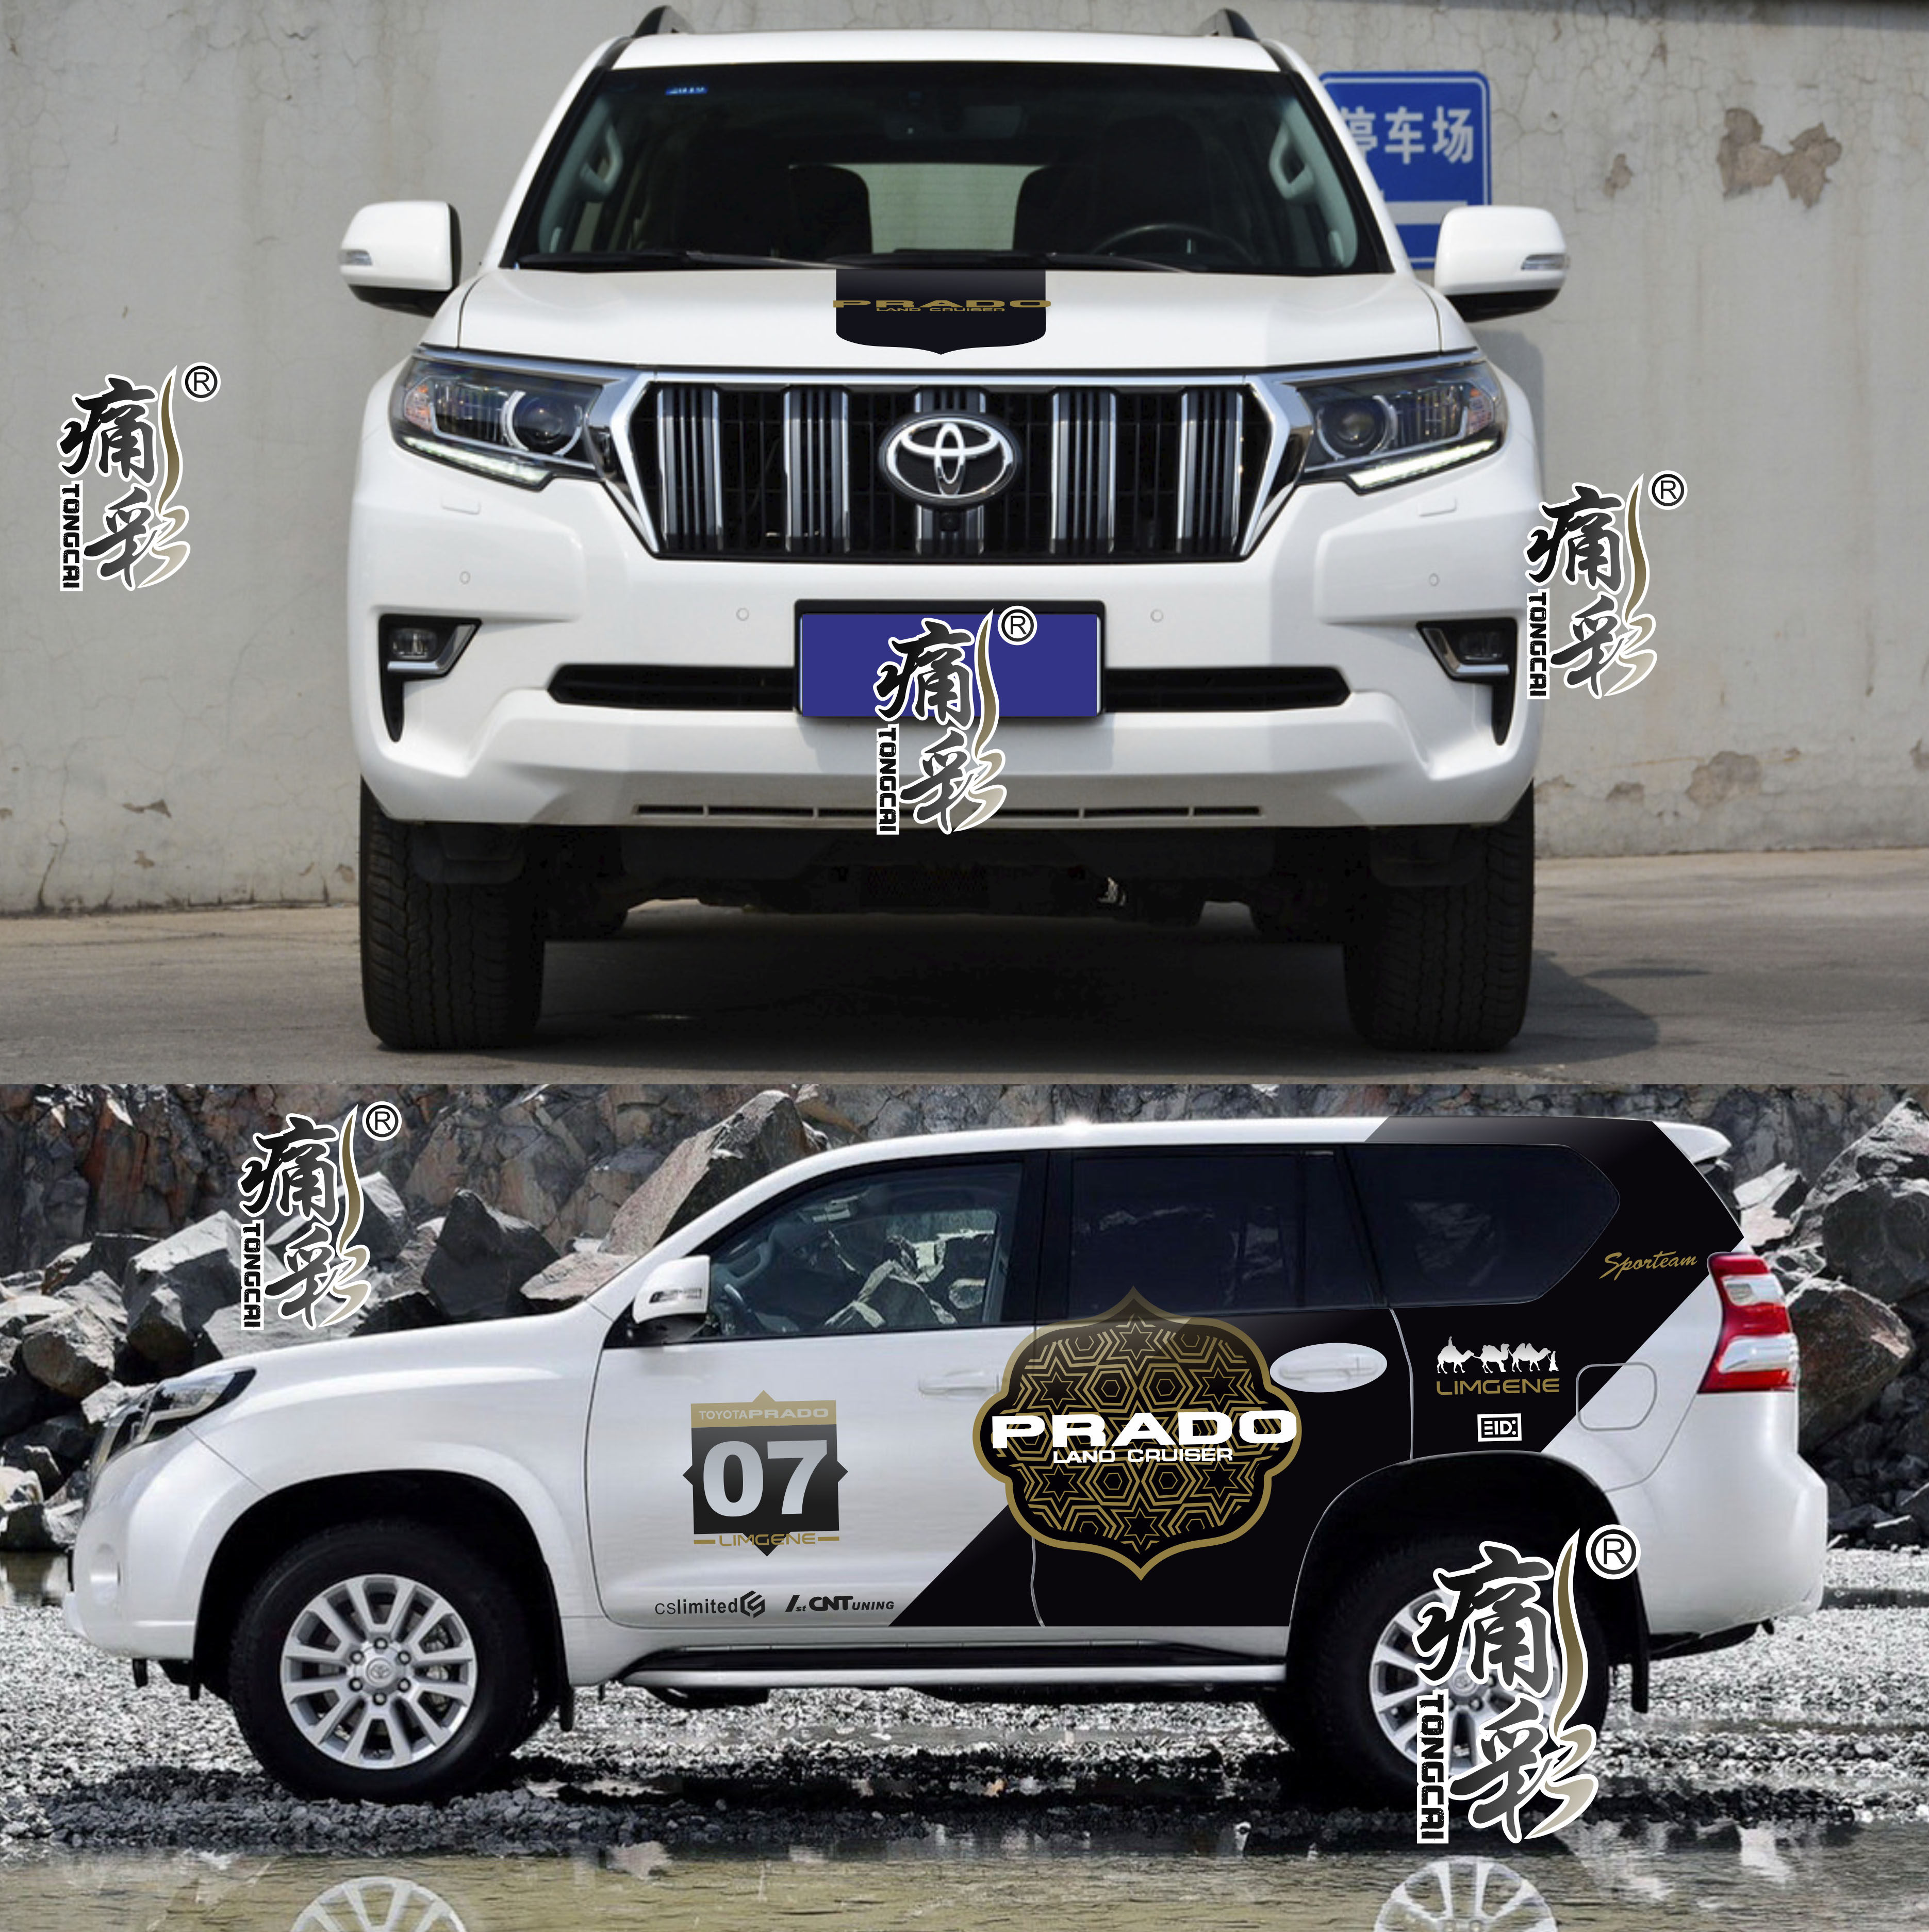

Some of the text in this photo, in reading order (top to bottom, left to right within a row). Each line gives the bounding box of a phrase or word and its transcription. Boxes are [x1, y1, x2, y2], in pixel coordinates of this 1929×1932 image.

[1341, 105, 1474, 165] 停车场
[833, 300, 1051, 308] PRADO
[1599, 1251, 1698, 1281] Sporteam
[1436, 1378, 1560, 1396] LIMGENE
[992, 1410, 1297, 1449] PRADO
[1053, 1448, 1233, 1464] LAND CRUISER
[703, 1440, 828, 1517] 07
[719, 1532, 816, 1547] LIMGENE
[655, 1597, 738, 1615] cslimited
